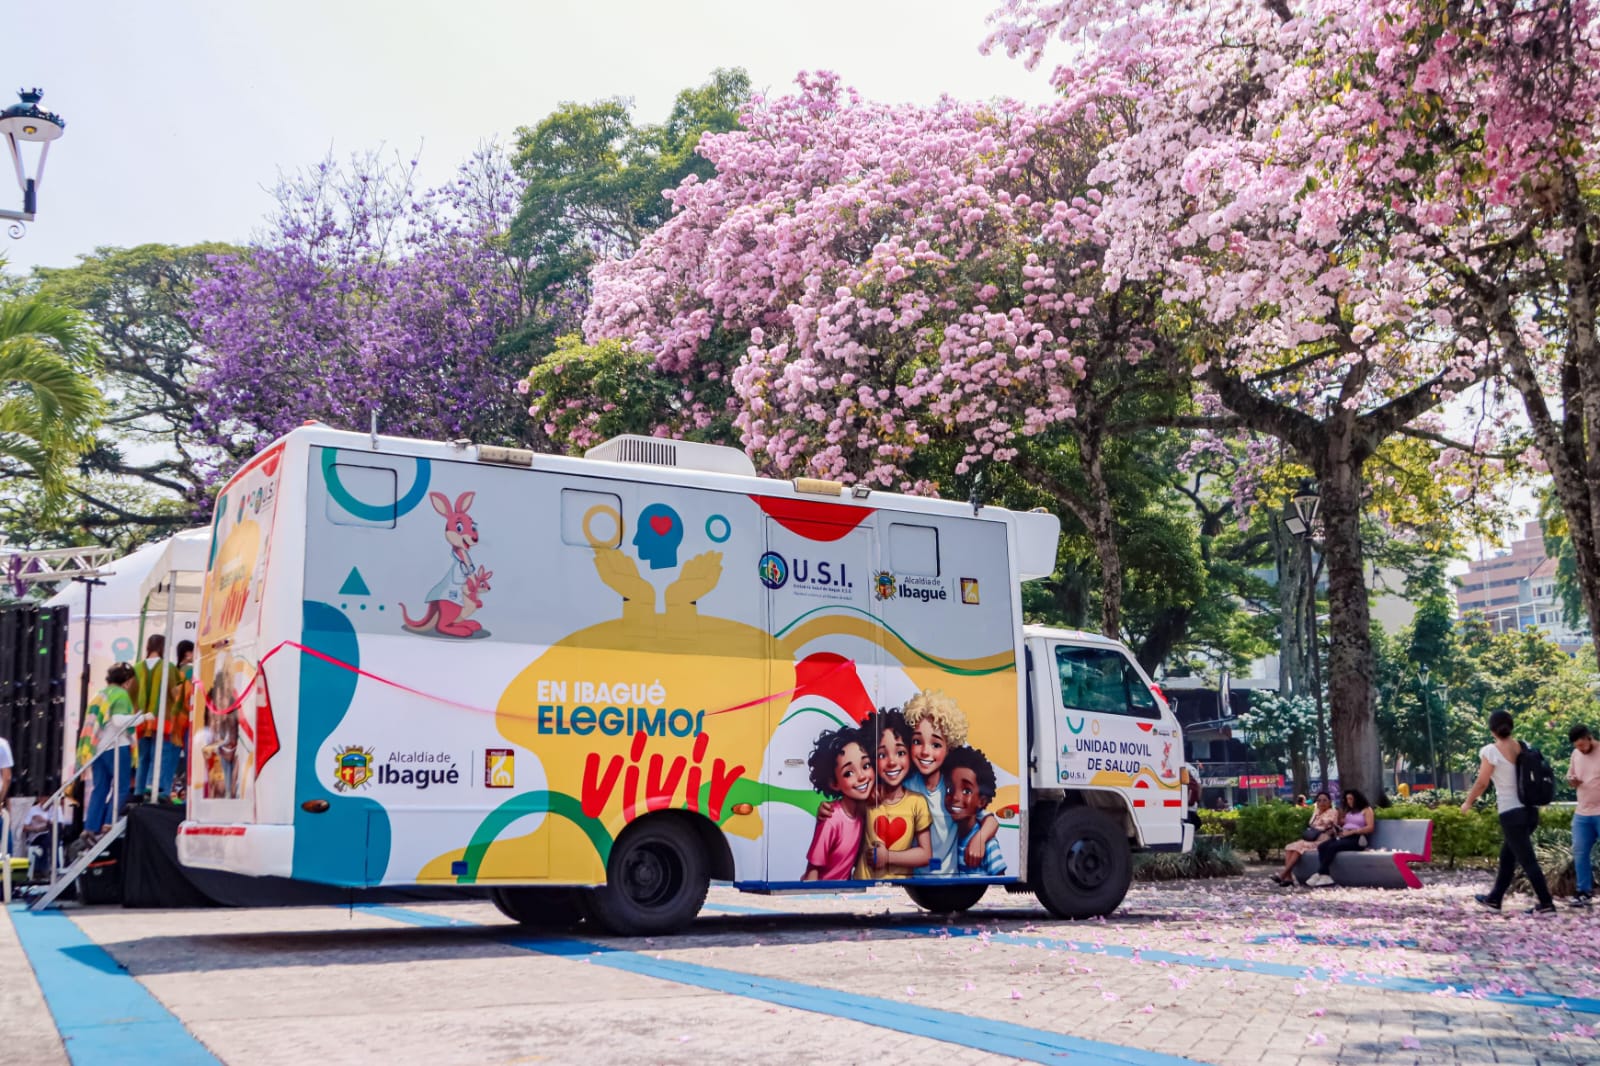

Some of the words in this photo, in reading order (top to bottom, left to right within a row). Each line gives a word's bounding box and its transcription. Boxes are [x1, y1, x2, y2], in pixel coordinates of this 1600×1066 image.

[793, 558, 853, 588] U.S.I.
[899, 584, 947, 603] Ibagué
[537, 680, 566, 703] EN
[1076, 739, 1117, 754] UNIDAD
[1120, 743, 1152, 756] MOVIL
[436, 754, 451, 763] de
[1088, 758, 1102, 770] DE
[1105, 760, 1140, 773] SALUD
[378, 764, 459, 790] Ibagué
